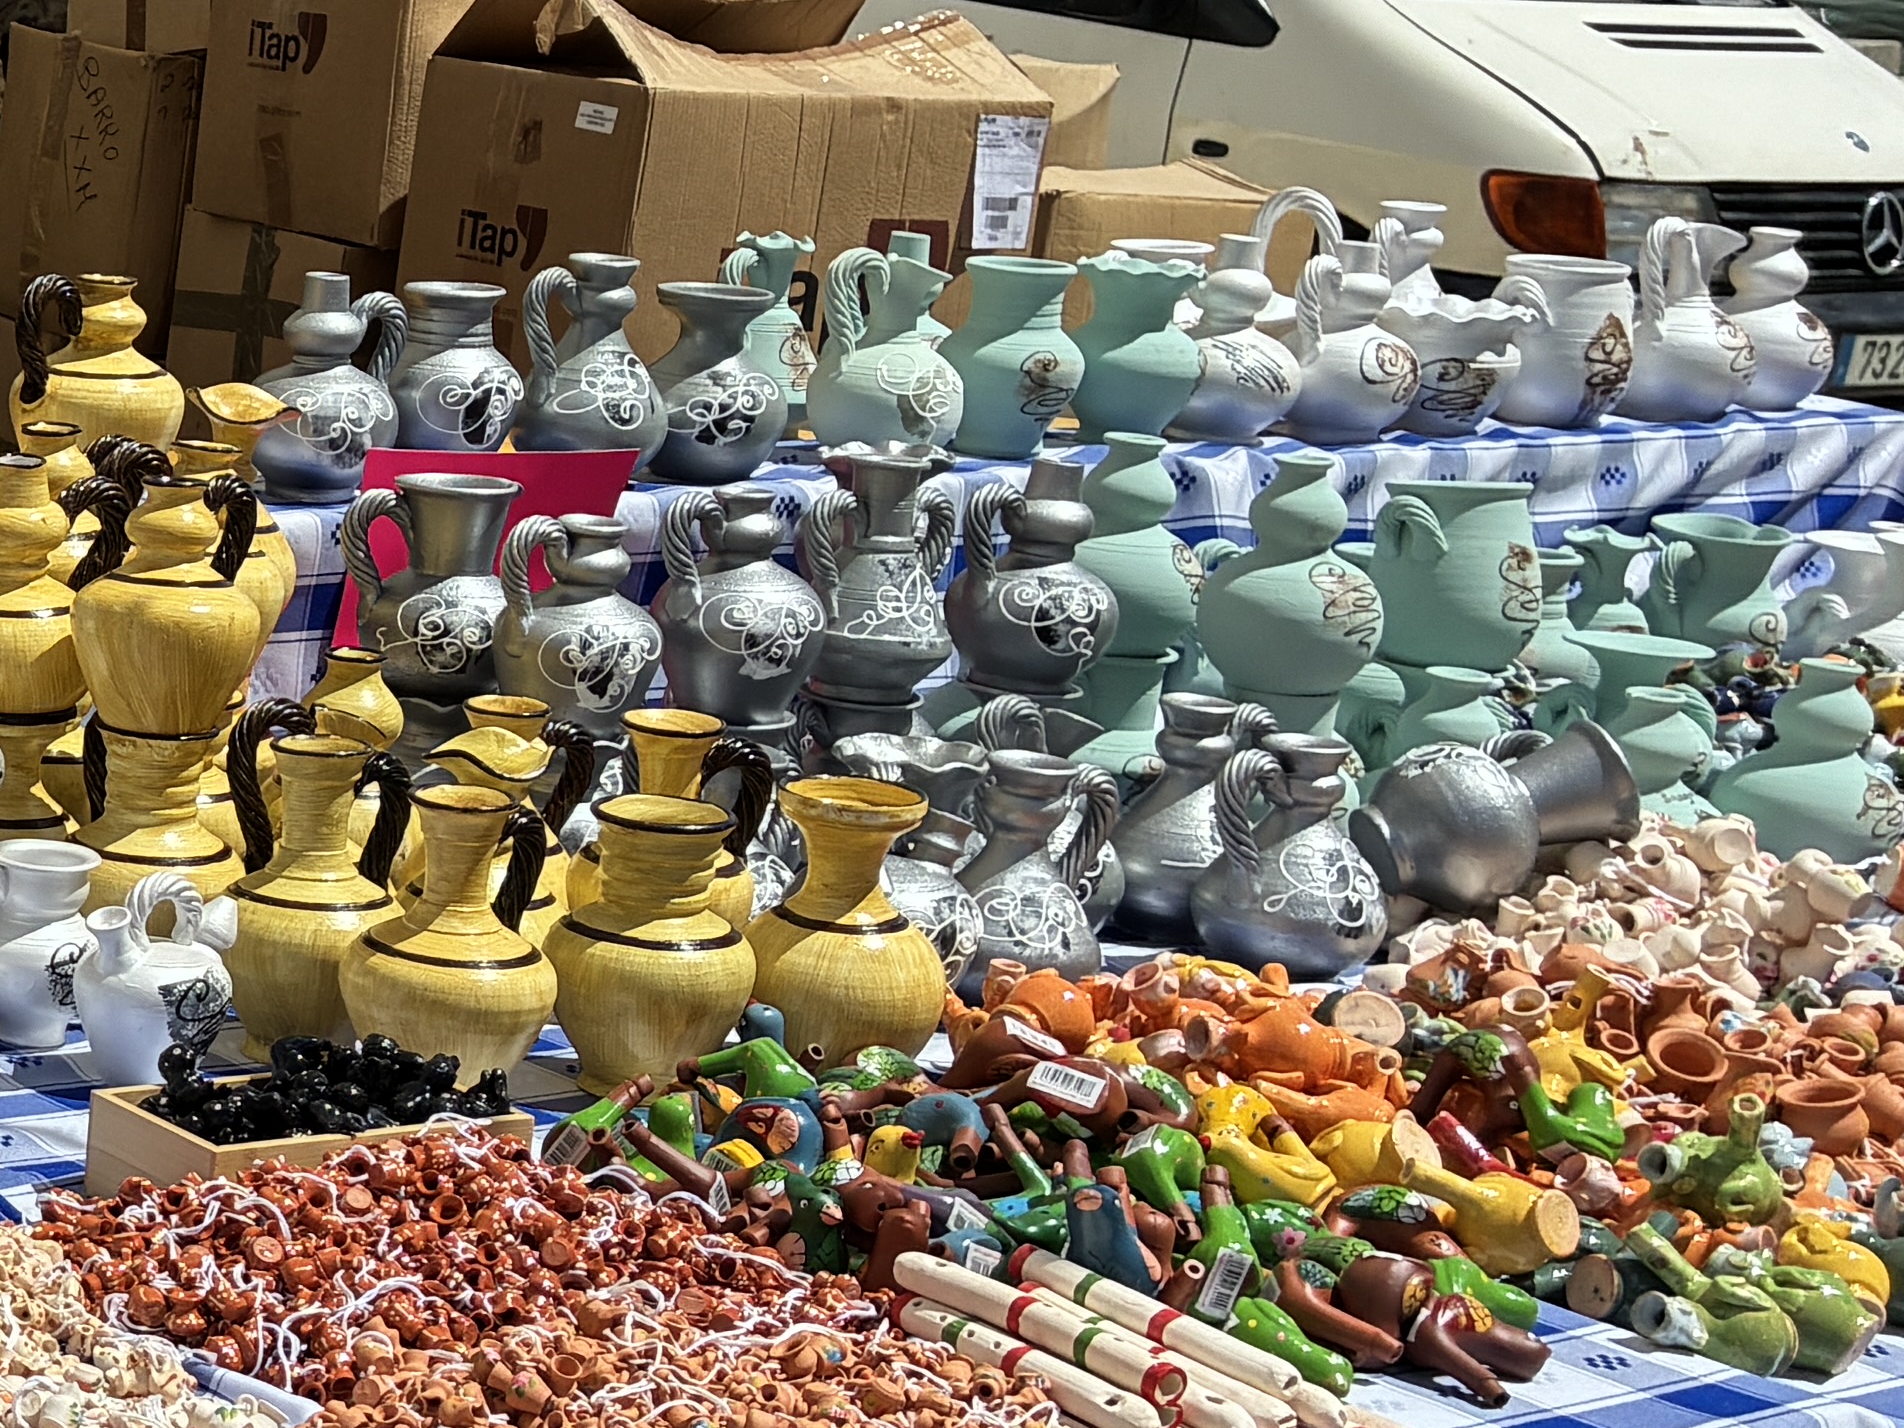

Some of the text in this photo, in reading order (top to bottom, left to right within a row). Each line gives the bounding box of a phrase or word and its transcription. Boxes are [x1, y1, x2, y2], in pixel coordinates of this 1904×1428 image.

[247, 19, 301, 72] iTap
[76, 56, 120, 161] BARRO
[456, 208, 519, 268] iTap
